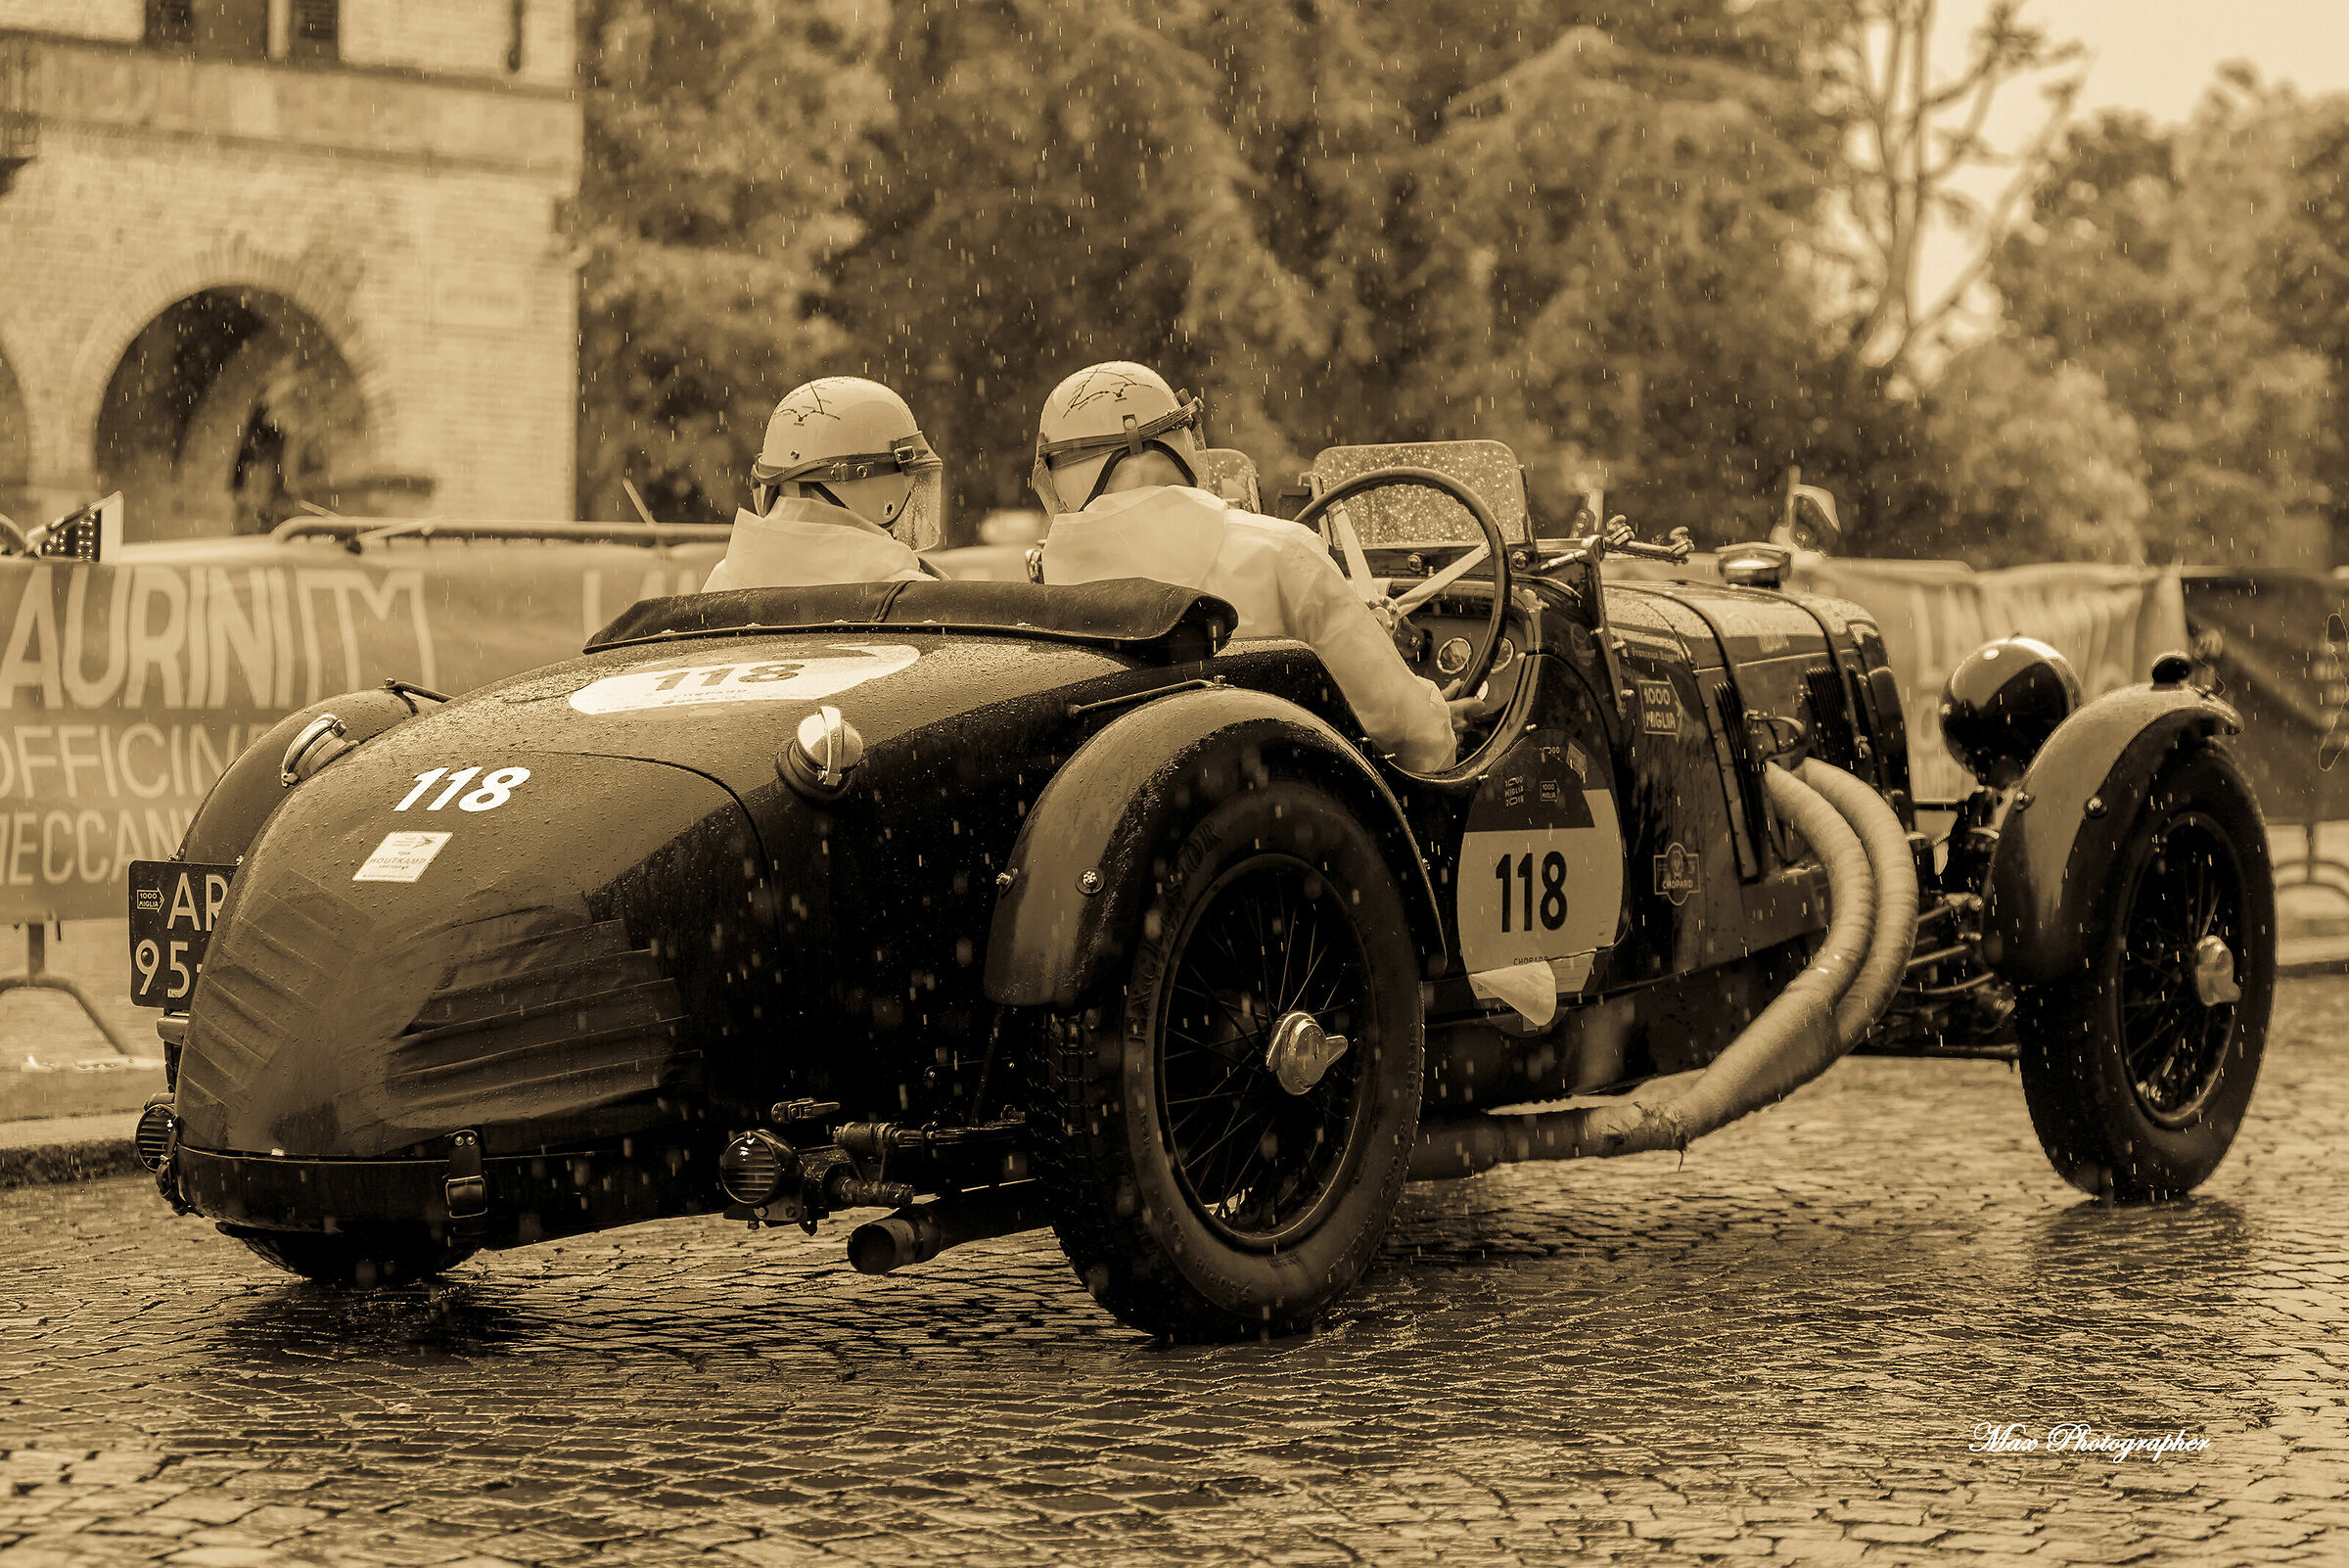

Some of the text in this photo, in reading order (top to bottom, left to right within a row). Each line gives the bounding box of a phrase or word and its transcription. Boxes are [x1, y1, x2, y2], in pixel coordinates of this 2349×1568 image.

[654, 663, 805, 691] 118
[1644, 687, 1670, 706] 1000
[1645, 711, 1676, 729] MIGLIA
[392, 766, 531, 812] 118
[166, 872, 228, 931] AR
[1496, 851, 1568, 933] 118
